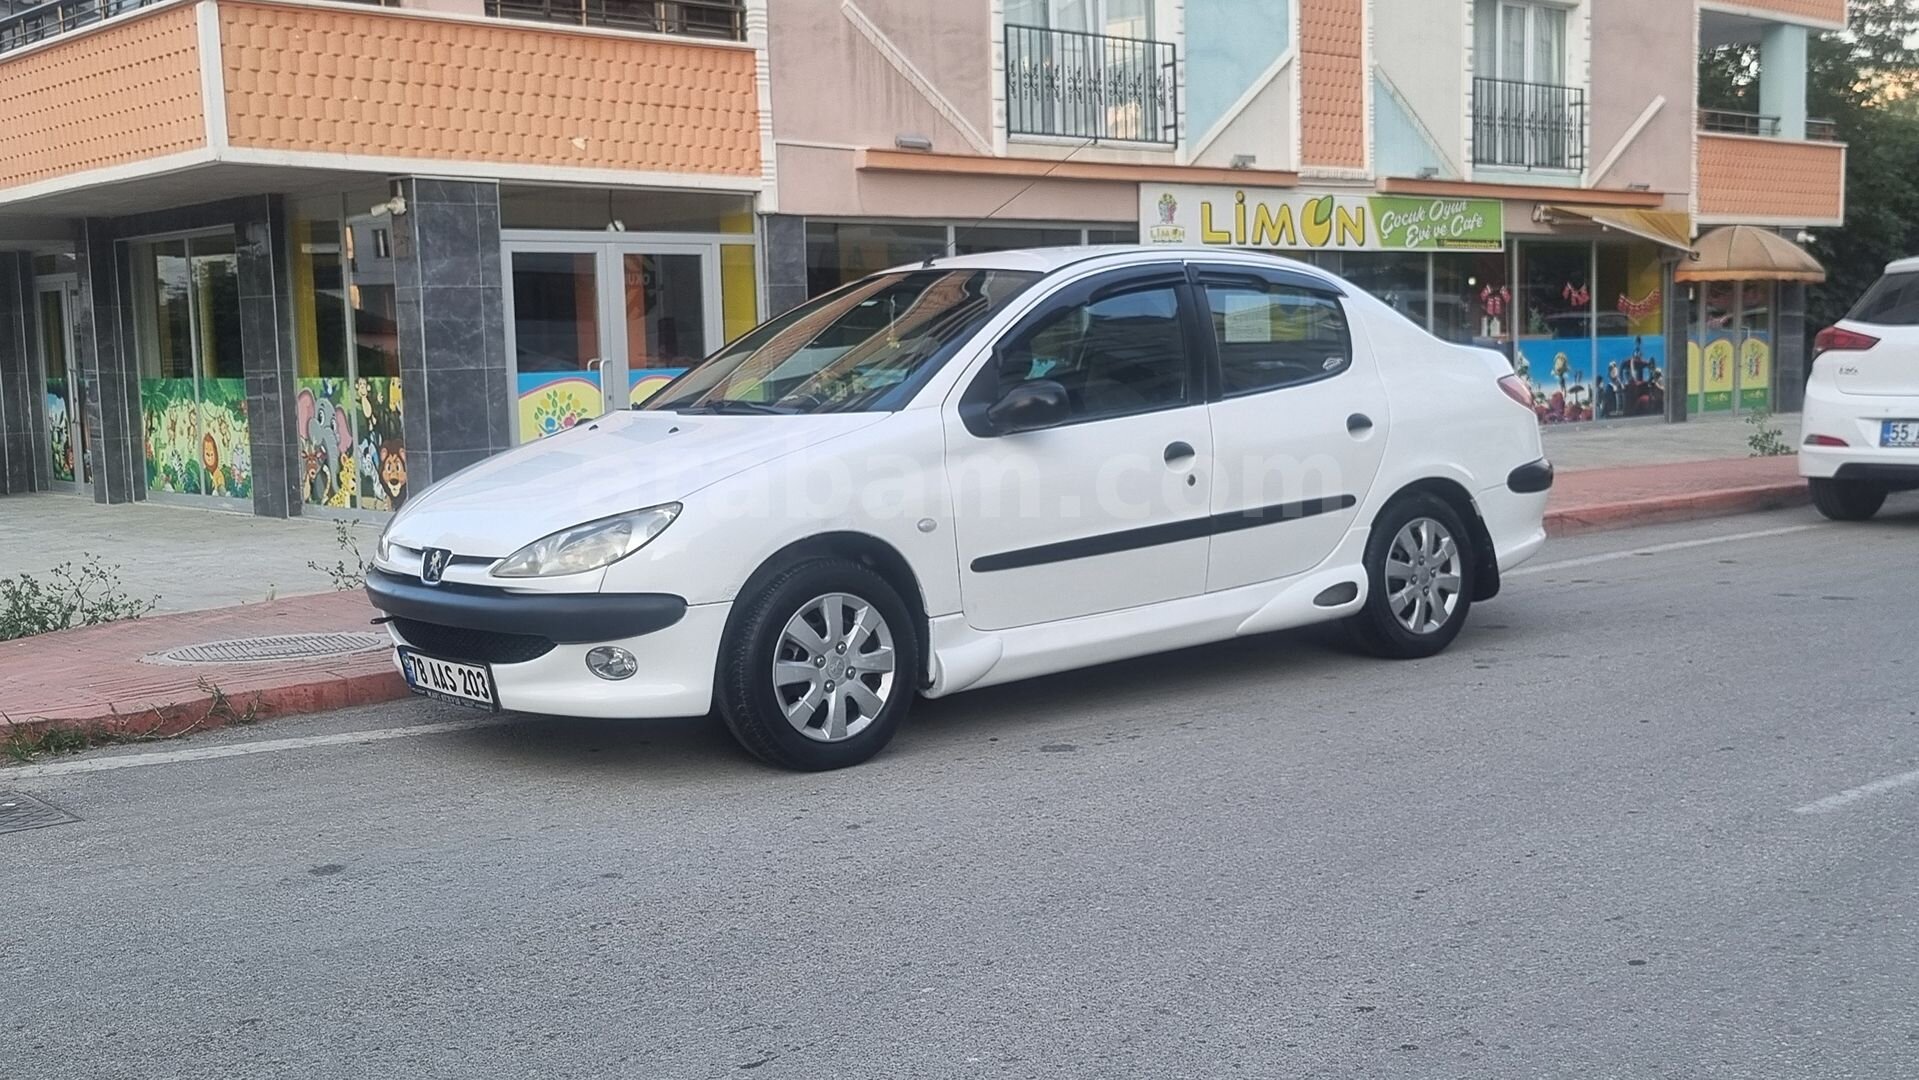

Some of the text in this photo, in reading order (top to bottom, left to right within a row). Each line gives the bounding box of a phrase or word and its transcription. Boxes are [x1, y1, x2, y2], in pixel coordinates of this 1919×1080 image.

[1381, 200, 1467, 239] Çocuk Oyun
[1405, 213, 1483, 248] Evi ve Cafe
[1891, 423, 1909, 440] 55
[408, 655, 429, 685] 78
[429, 661, 458, 693] AAS
[458, 667, 489, 699] 203
